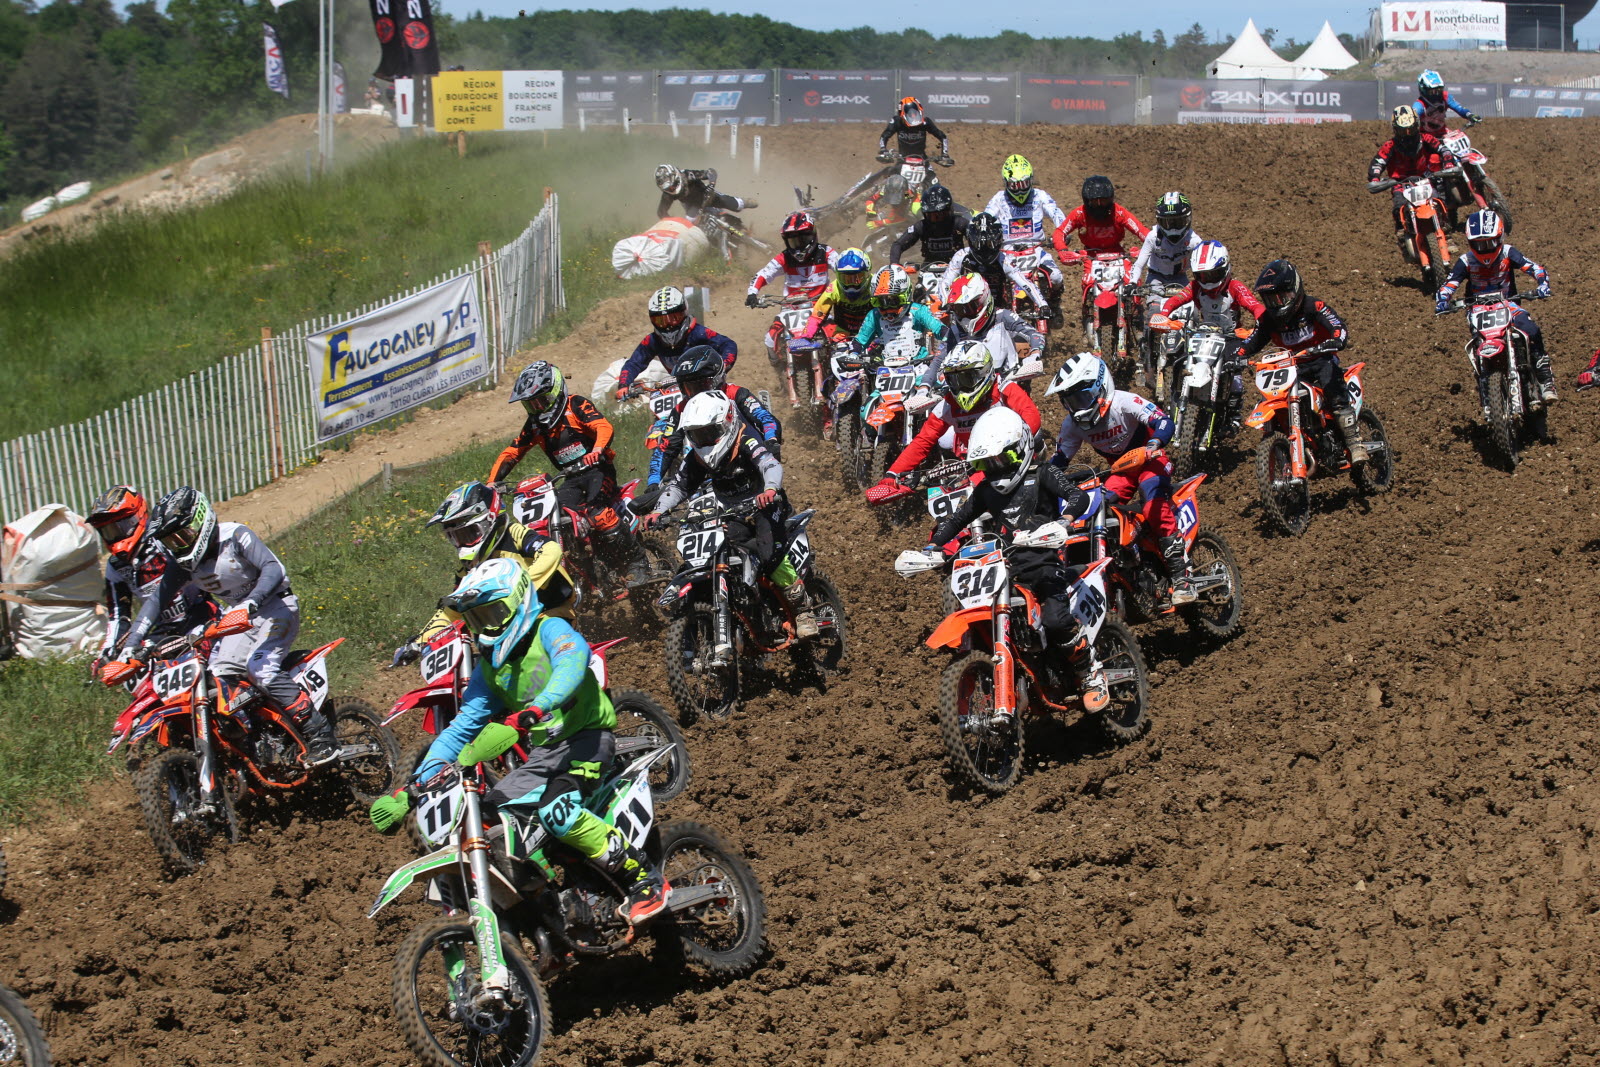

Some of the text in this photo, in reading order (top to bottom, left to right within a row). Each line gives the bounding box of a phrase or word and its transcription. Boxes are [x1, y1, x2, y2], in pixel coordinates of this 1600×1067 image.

[1434, 14, 1499, 24] Montbéliard
[821, 95, 871, 104] 24MX
[928, 94, 990, 104] AUTOMOTO
[1063, 99, 1106, 110] YAMAHA
[1450, 138, 1469, 153] 311
[1281, 326, 1310, 338] KENNY
[1476, 308, 1509, 331] 159
[327, 302, 477, 383] FAUCOGNEY T.P.
[327, 380, 373, 404] Terrassement
[383, 356, 432, 382] Assainissement
[368, 369, 440, 404] www.faucogney.com
[412, 386, 435, 401] CUBRY
[449, 364, 482, 385] FAVERNEY
[878, 375, 913, 392] 301
[1096, 363, 1106, 388] OAKLEY
[1261, 369, 1289, 389] 79
[1088, 424, 1123, 442] THOR
[929, 462, 969, 479] RENTHAL
[522, 494, 546, 525] 5
[682, 532, 717, 559] 214
[957, 565, 999, 601] 314
[426, 644, 453, 681] 321
[156, 663, 196, 698] 348
[424, 795, 452, 837] 11
[544, 794, 575, 830] FOX
[614, 797, 652, 844] 11
[483, 917, 499, 969] DUNLOP
